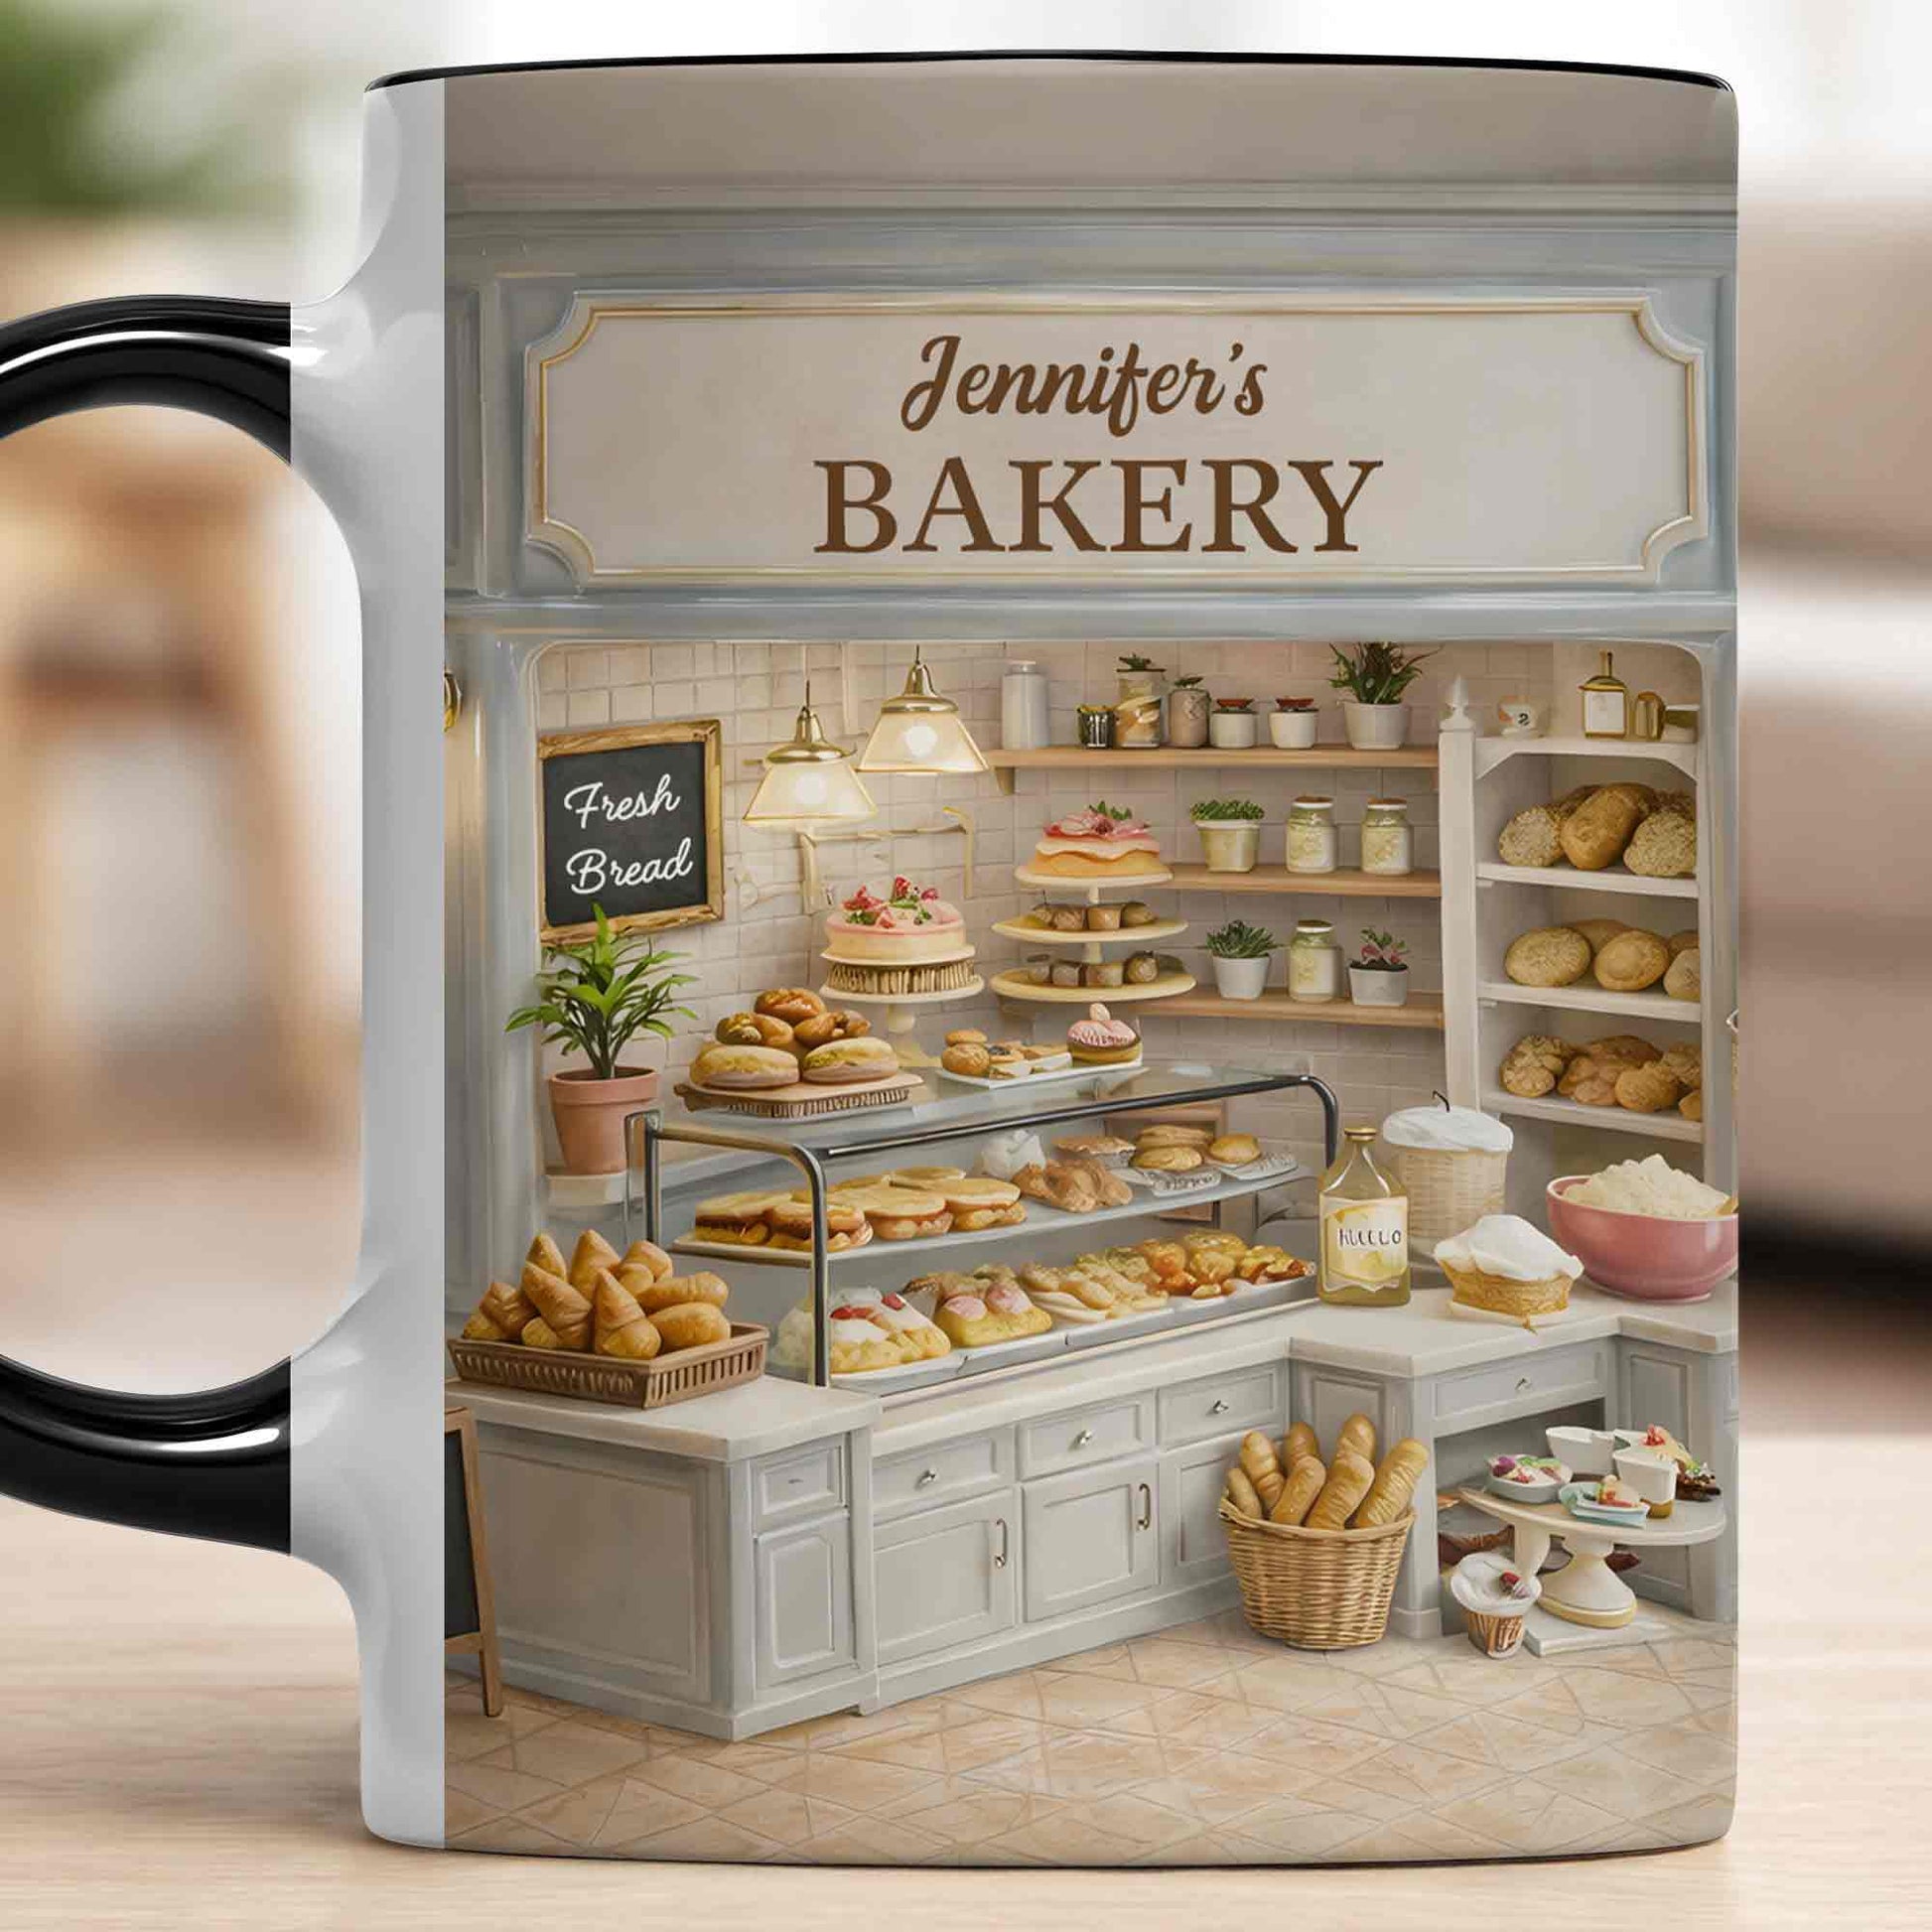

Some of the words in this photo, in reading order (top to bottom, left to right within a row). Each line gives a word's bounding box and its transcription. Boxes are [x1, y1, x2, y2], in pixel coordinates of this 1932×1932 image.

[900, 335, 1268, 438] Jennifer's
[812, 456, 1384, 554] BAKERY
[563, 773, 681, 829] Fresh
[566, 837, 694, 895] Bread
